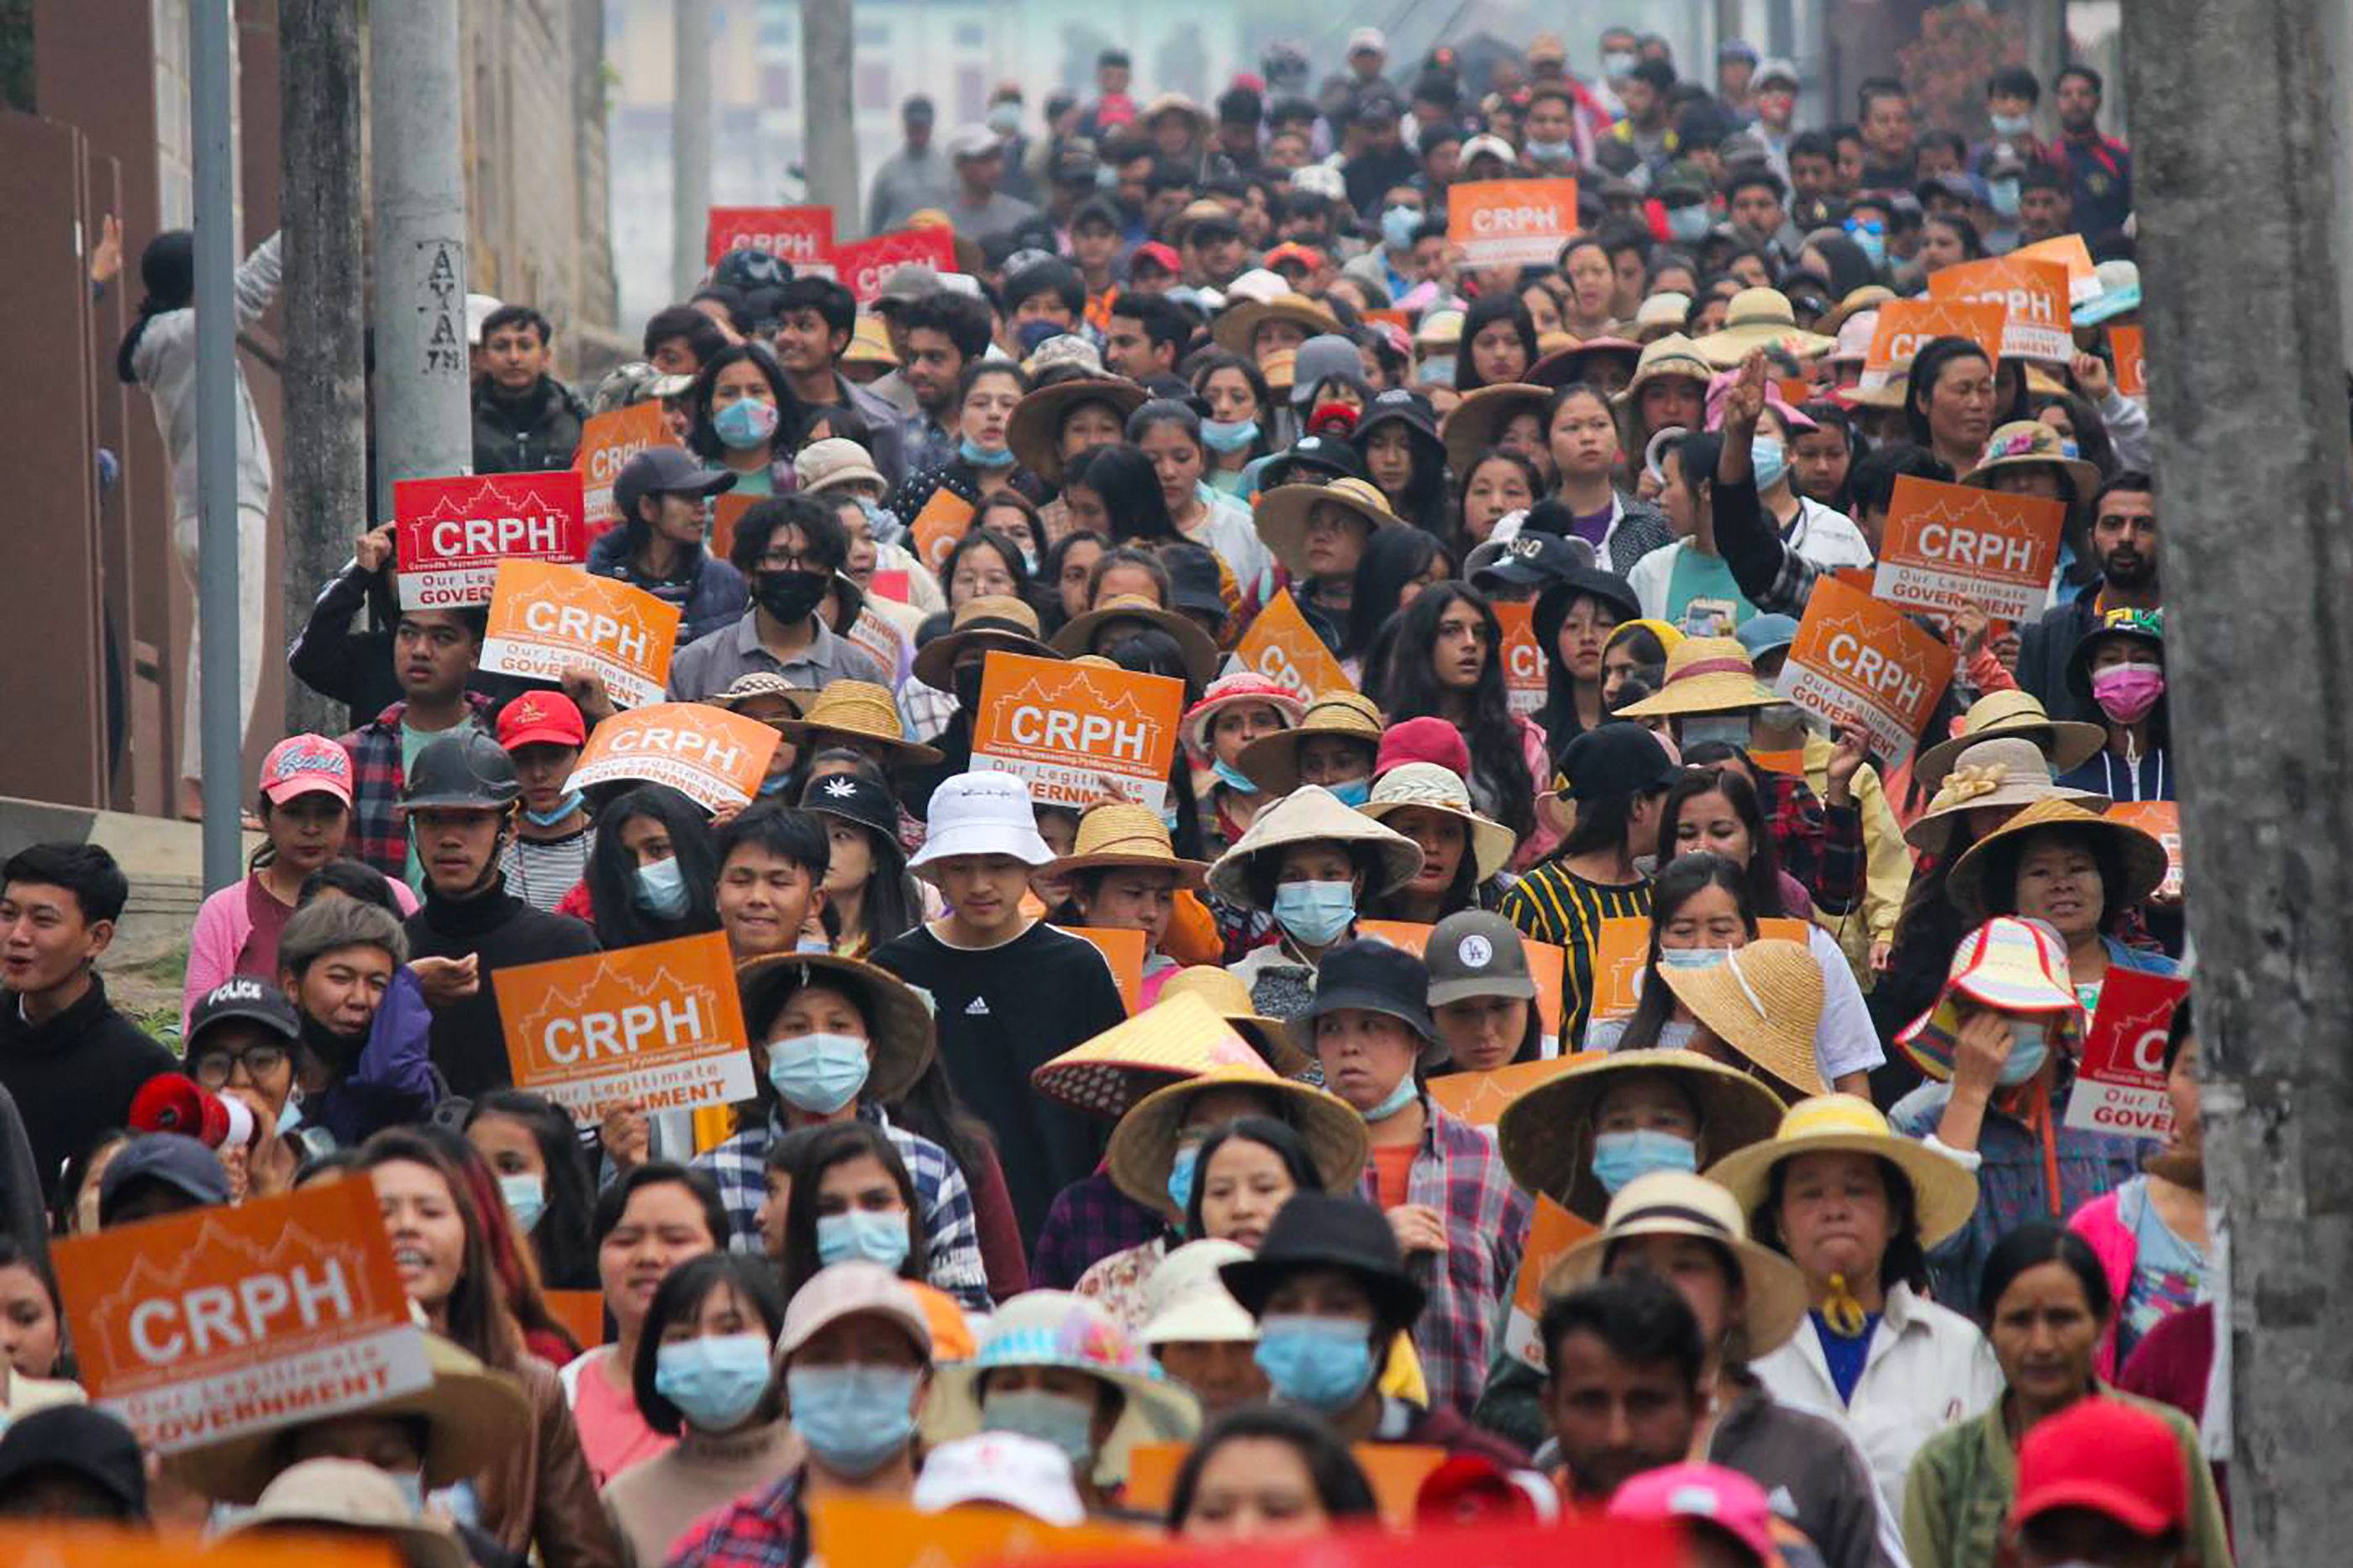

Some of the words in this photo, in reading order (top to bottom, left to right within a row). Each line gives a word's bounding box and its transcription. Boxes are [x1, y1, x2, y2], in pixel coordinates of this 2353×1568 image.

[1472, 205, 1556, 233] CRPH
[731, 232, 814, 257] CRPH
[431, 515, 556, 557] CRPH
[1918, 523, 2033, 572] CRPH
[422, 575, 456, 587] Our
[1898, 569, 1929, 584] Our
[1938, 576, 2028, 601] Legitimate
[507, 643, 540, 656] Our
[525, 600, 647, 663] CRPH
[1802, 672, 1832, 696] Our
[1827, 634, 1924, 713] CRPH
[609, 727, 739, 771] CRPH
[1011, 705, 1146, 760] CRPH
[545, 994, 703, 1065] CRPH
[2104, 1088, 2147, 1107] Our
[130, 1257, 354, 1365] CRPH
